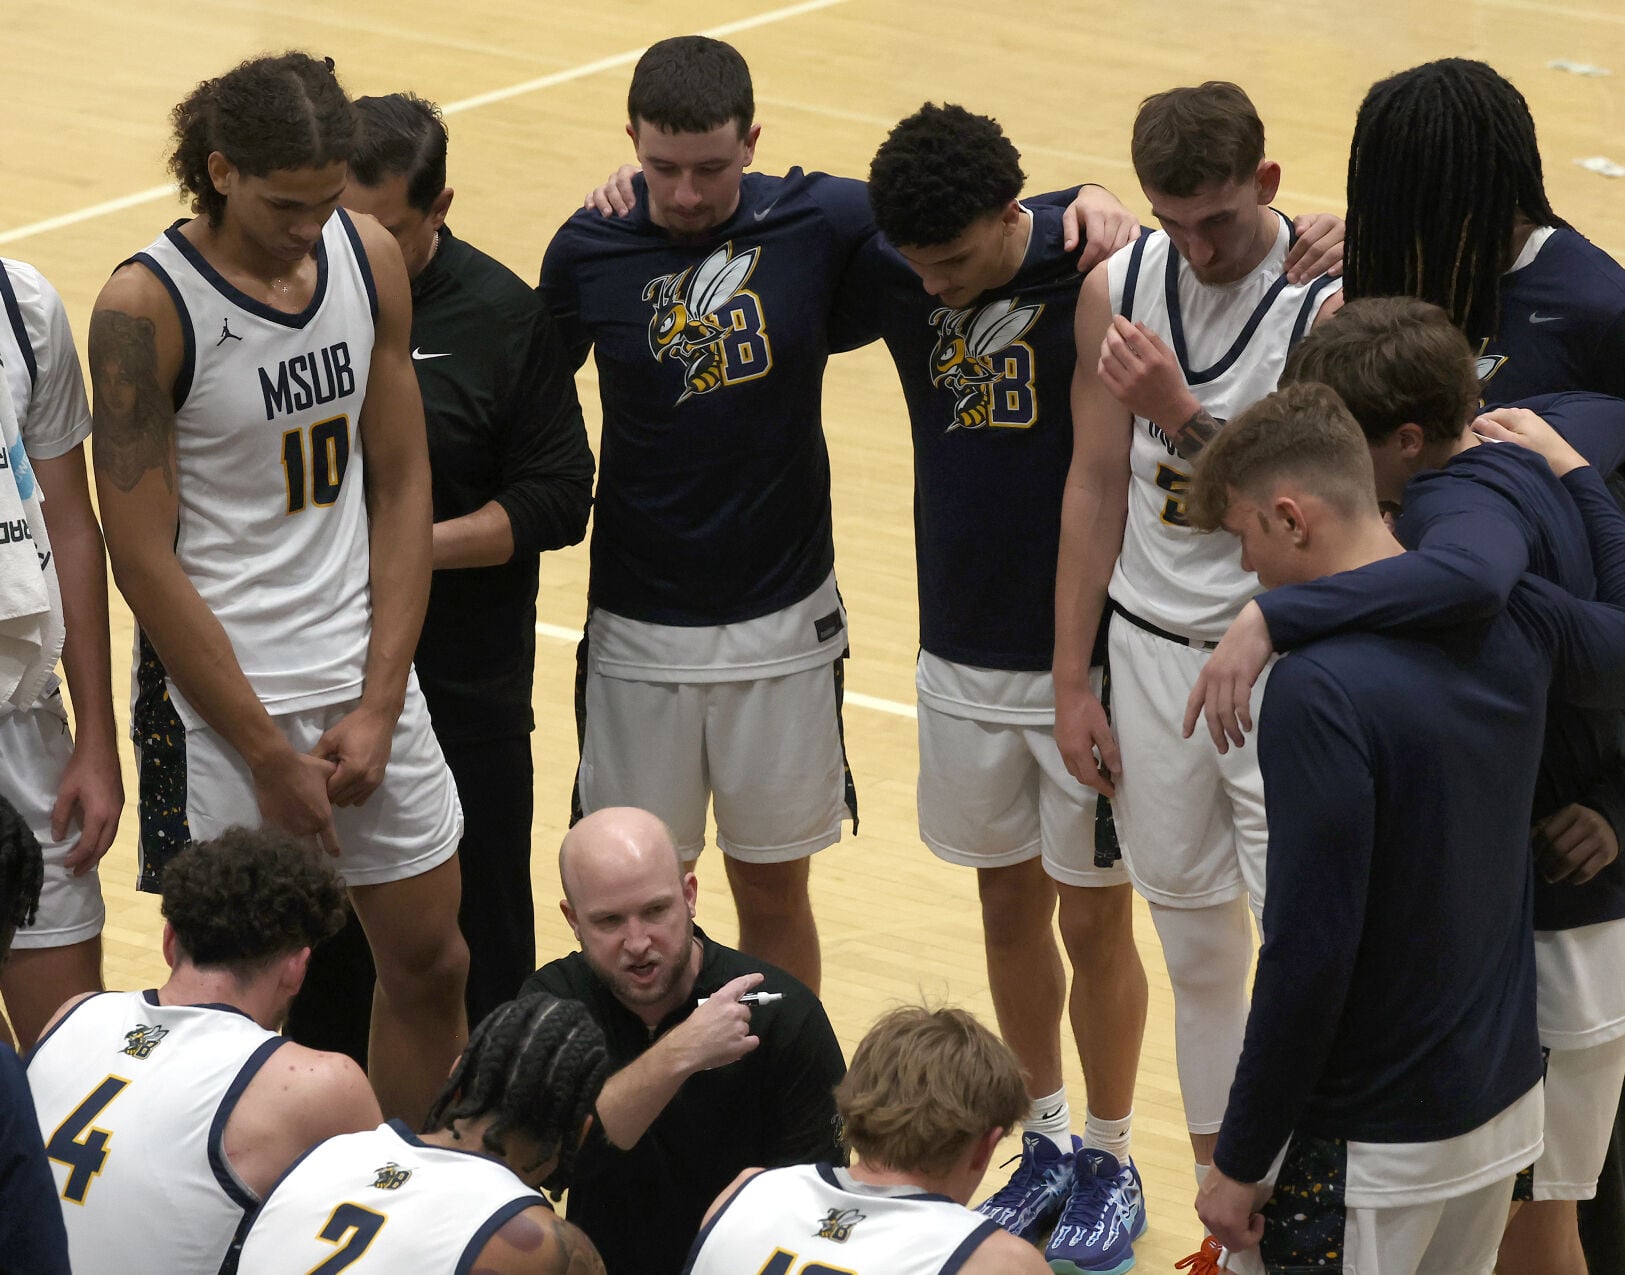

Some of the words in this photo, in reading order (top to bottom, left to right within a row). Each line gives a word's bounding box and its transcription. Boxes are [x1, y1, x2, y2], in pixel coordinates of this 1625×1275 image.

[258, 341, 355, 421] MSUB
[708, 289, 774, 386] B
[986, 340, 1038, 429] B
[280, 413, 350, 516] 10
[45, 1073, 133, 1206] 4
